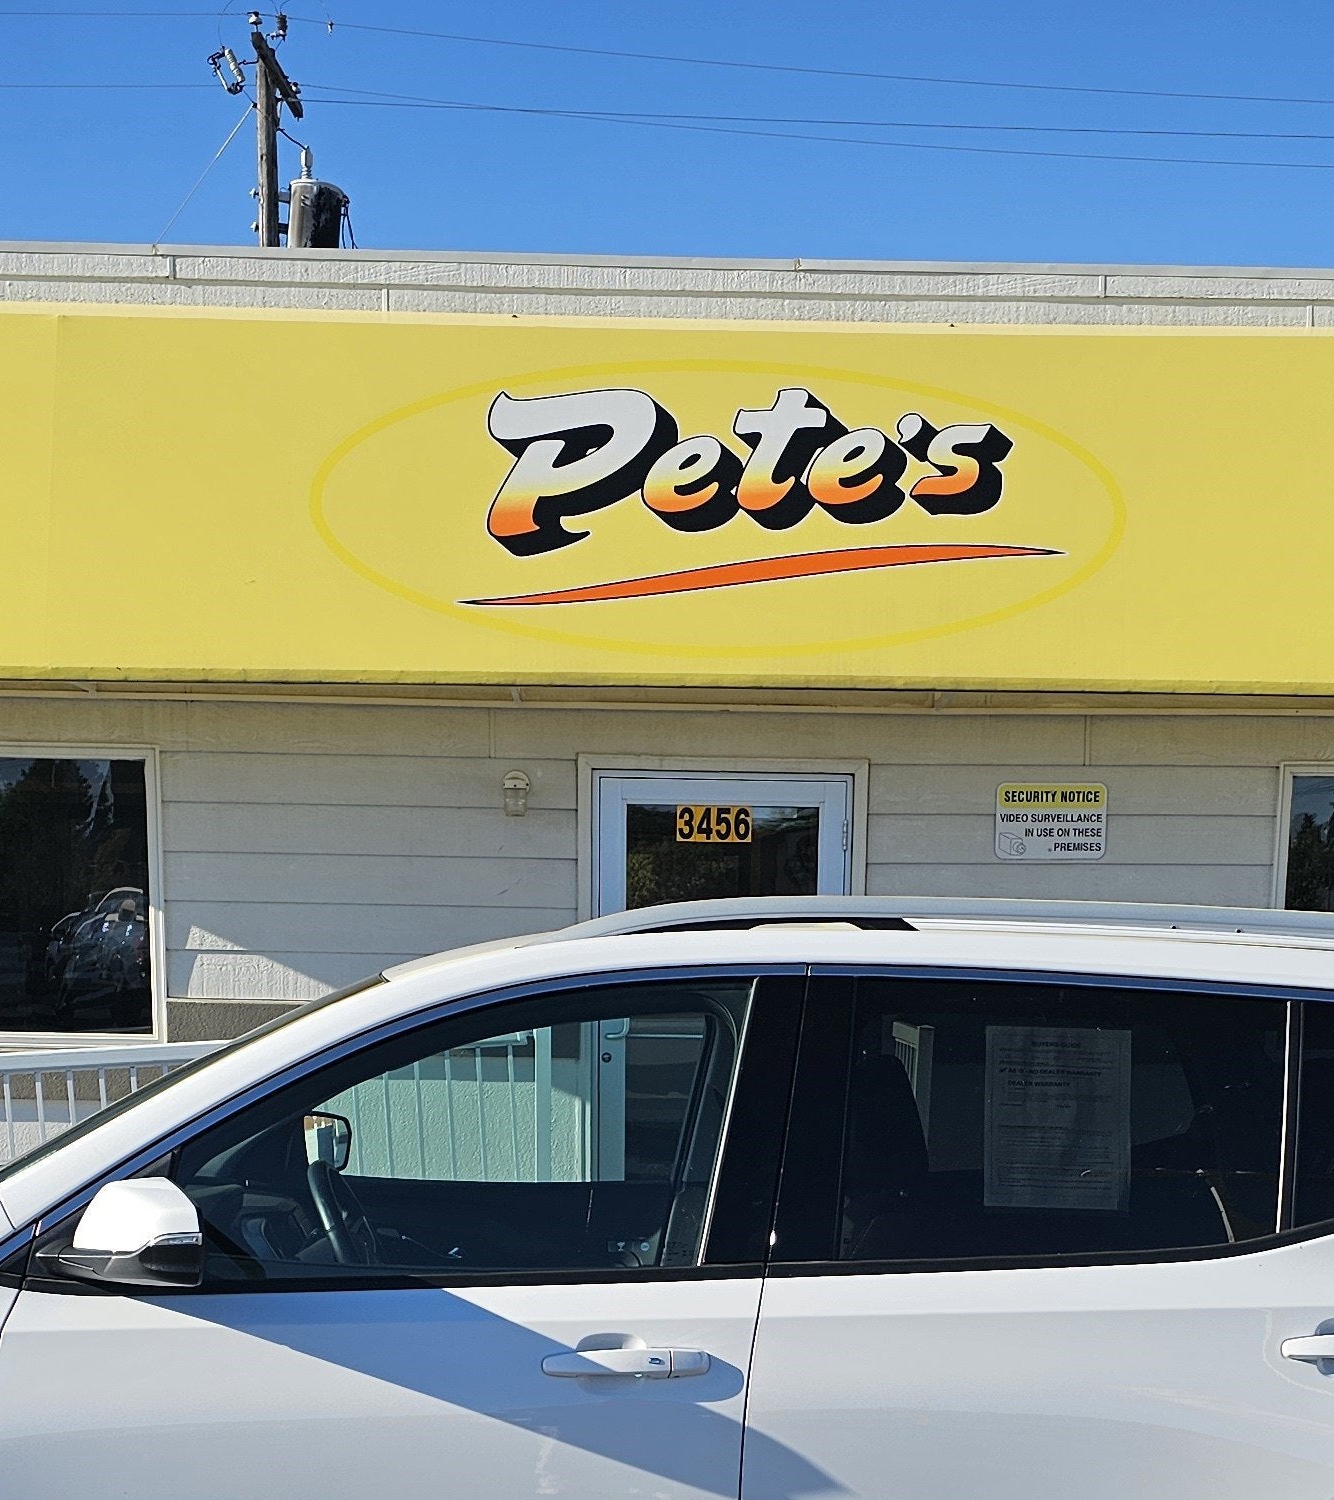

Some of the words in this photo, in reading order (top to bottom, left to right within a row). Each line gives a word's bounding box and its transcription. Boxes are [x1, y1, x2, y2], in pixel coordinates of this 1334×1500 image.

[487, 387, 1013, 557] Pete's
[1004, 790, 1057, 803] SECURITY
[1060, 790, 1100, 803] NOTICE
[677, 806, 751, 841] 3456
[999, 813, 1028, 823] VIDEO
[1030, 813, 1103, 823] SURVEILLANCE
[1024, 827, 1034, 837] IN
[1036, 827, 1055, 837] USE
[1057, 827, 1071, 837] ON
[1072, 827, 1102, 837] THESE
[1053, 842, 1102, 852] PREMISES
